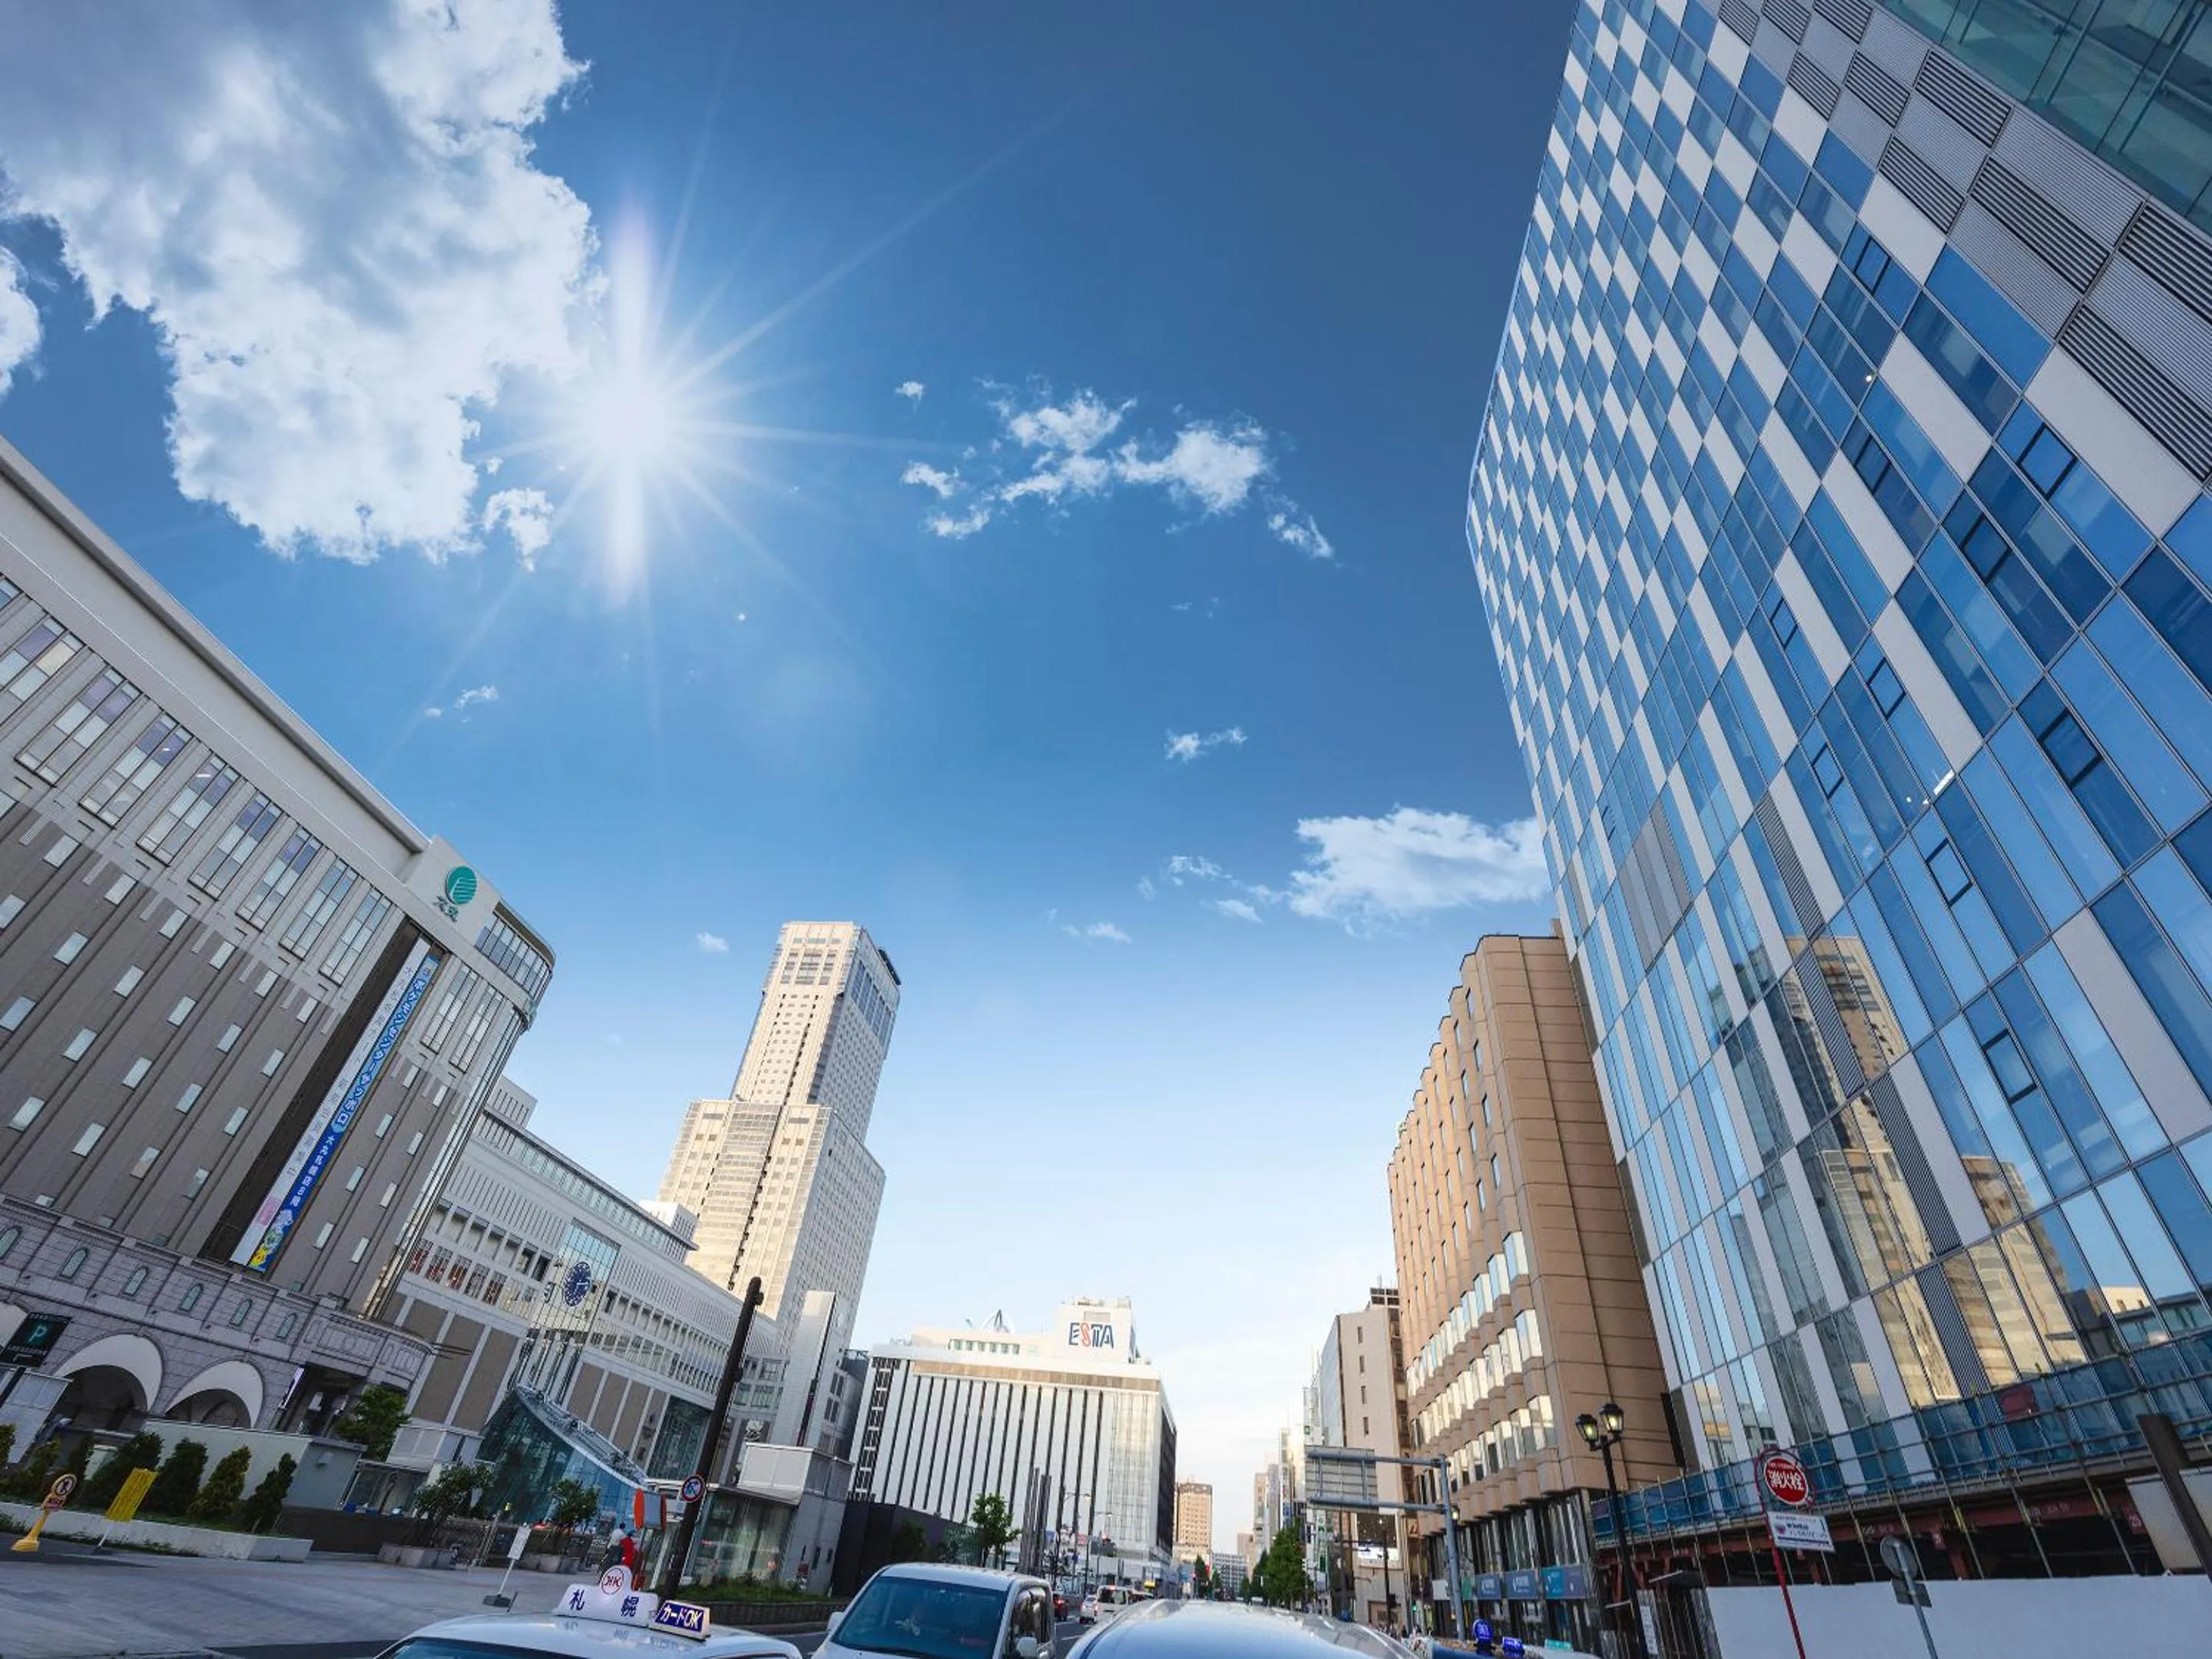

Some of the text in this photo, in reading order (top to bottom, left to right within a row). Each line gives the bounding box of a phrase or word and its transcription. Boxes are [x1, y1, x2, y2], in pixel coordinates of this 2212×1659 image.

[27, 1325, 48, 1343] P
[1068, 1322, 1114, 1349] ESTA
[1768, 1470, 1804, 1491] 消火栓
[661, 1604, 703, 1630] カードOK
